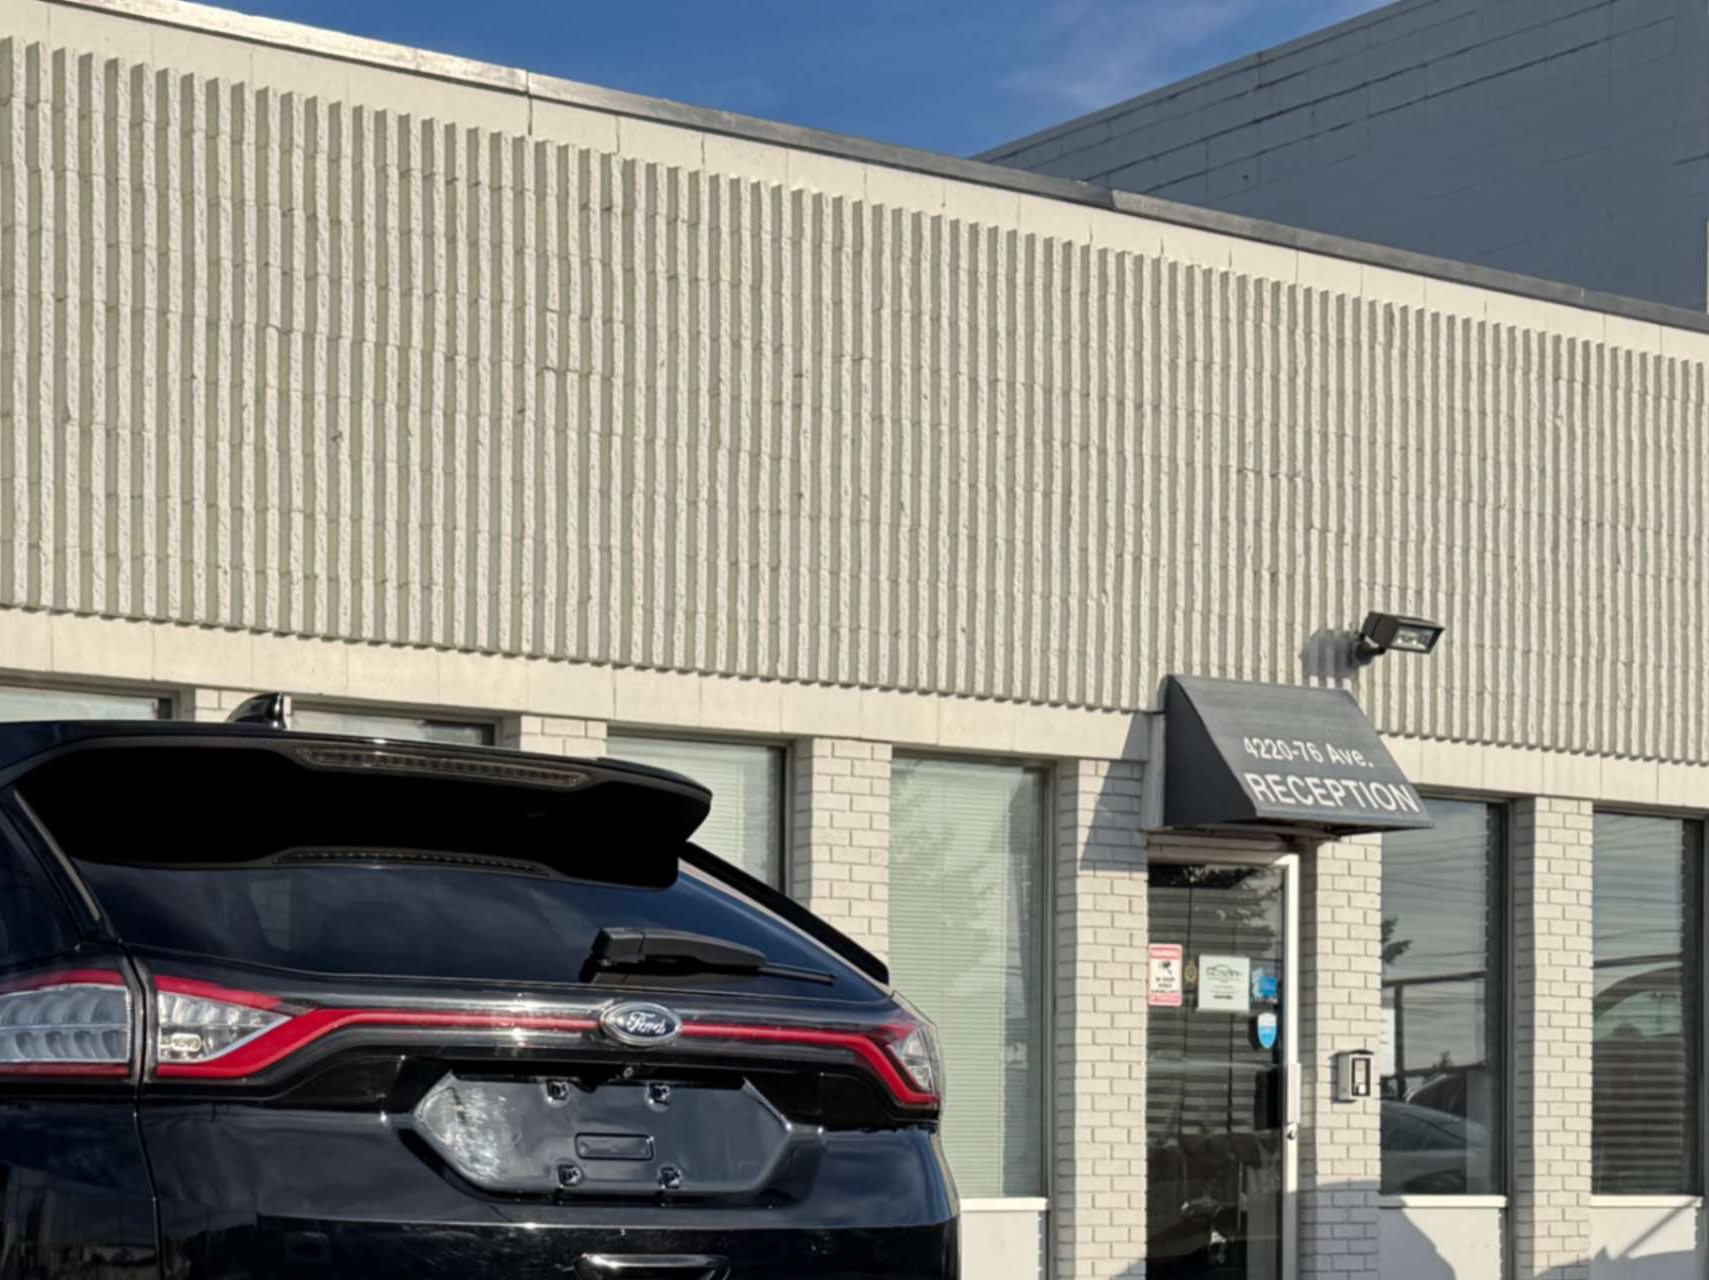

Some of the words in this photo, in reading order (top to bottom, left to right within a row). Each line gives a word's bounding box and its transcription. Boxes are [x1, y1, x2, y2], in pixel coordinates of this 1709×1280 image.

[1243, 736, 1324, 764] 4220-76
[1326, 743, 1375, 768] Ave.
[1244, 772, 1420, 813] RECEPTION
[626, 1011, 667, 1034] Ford
